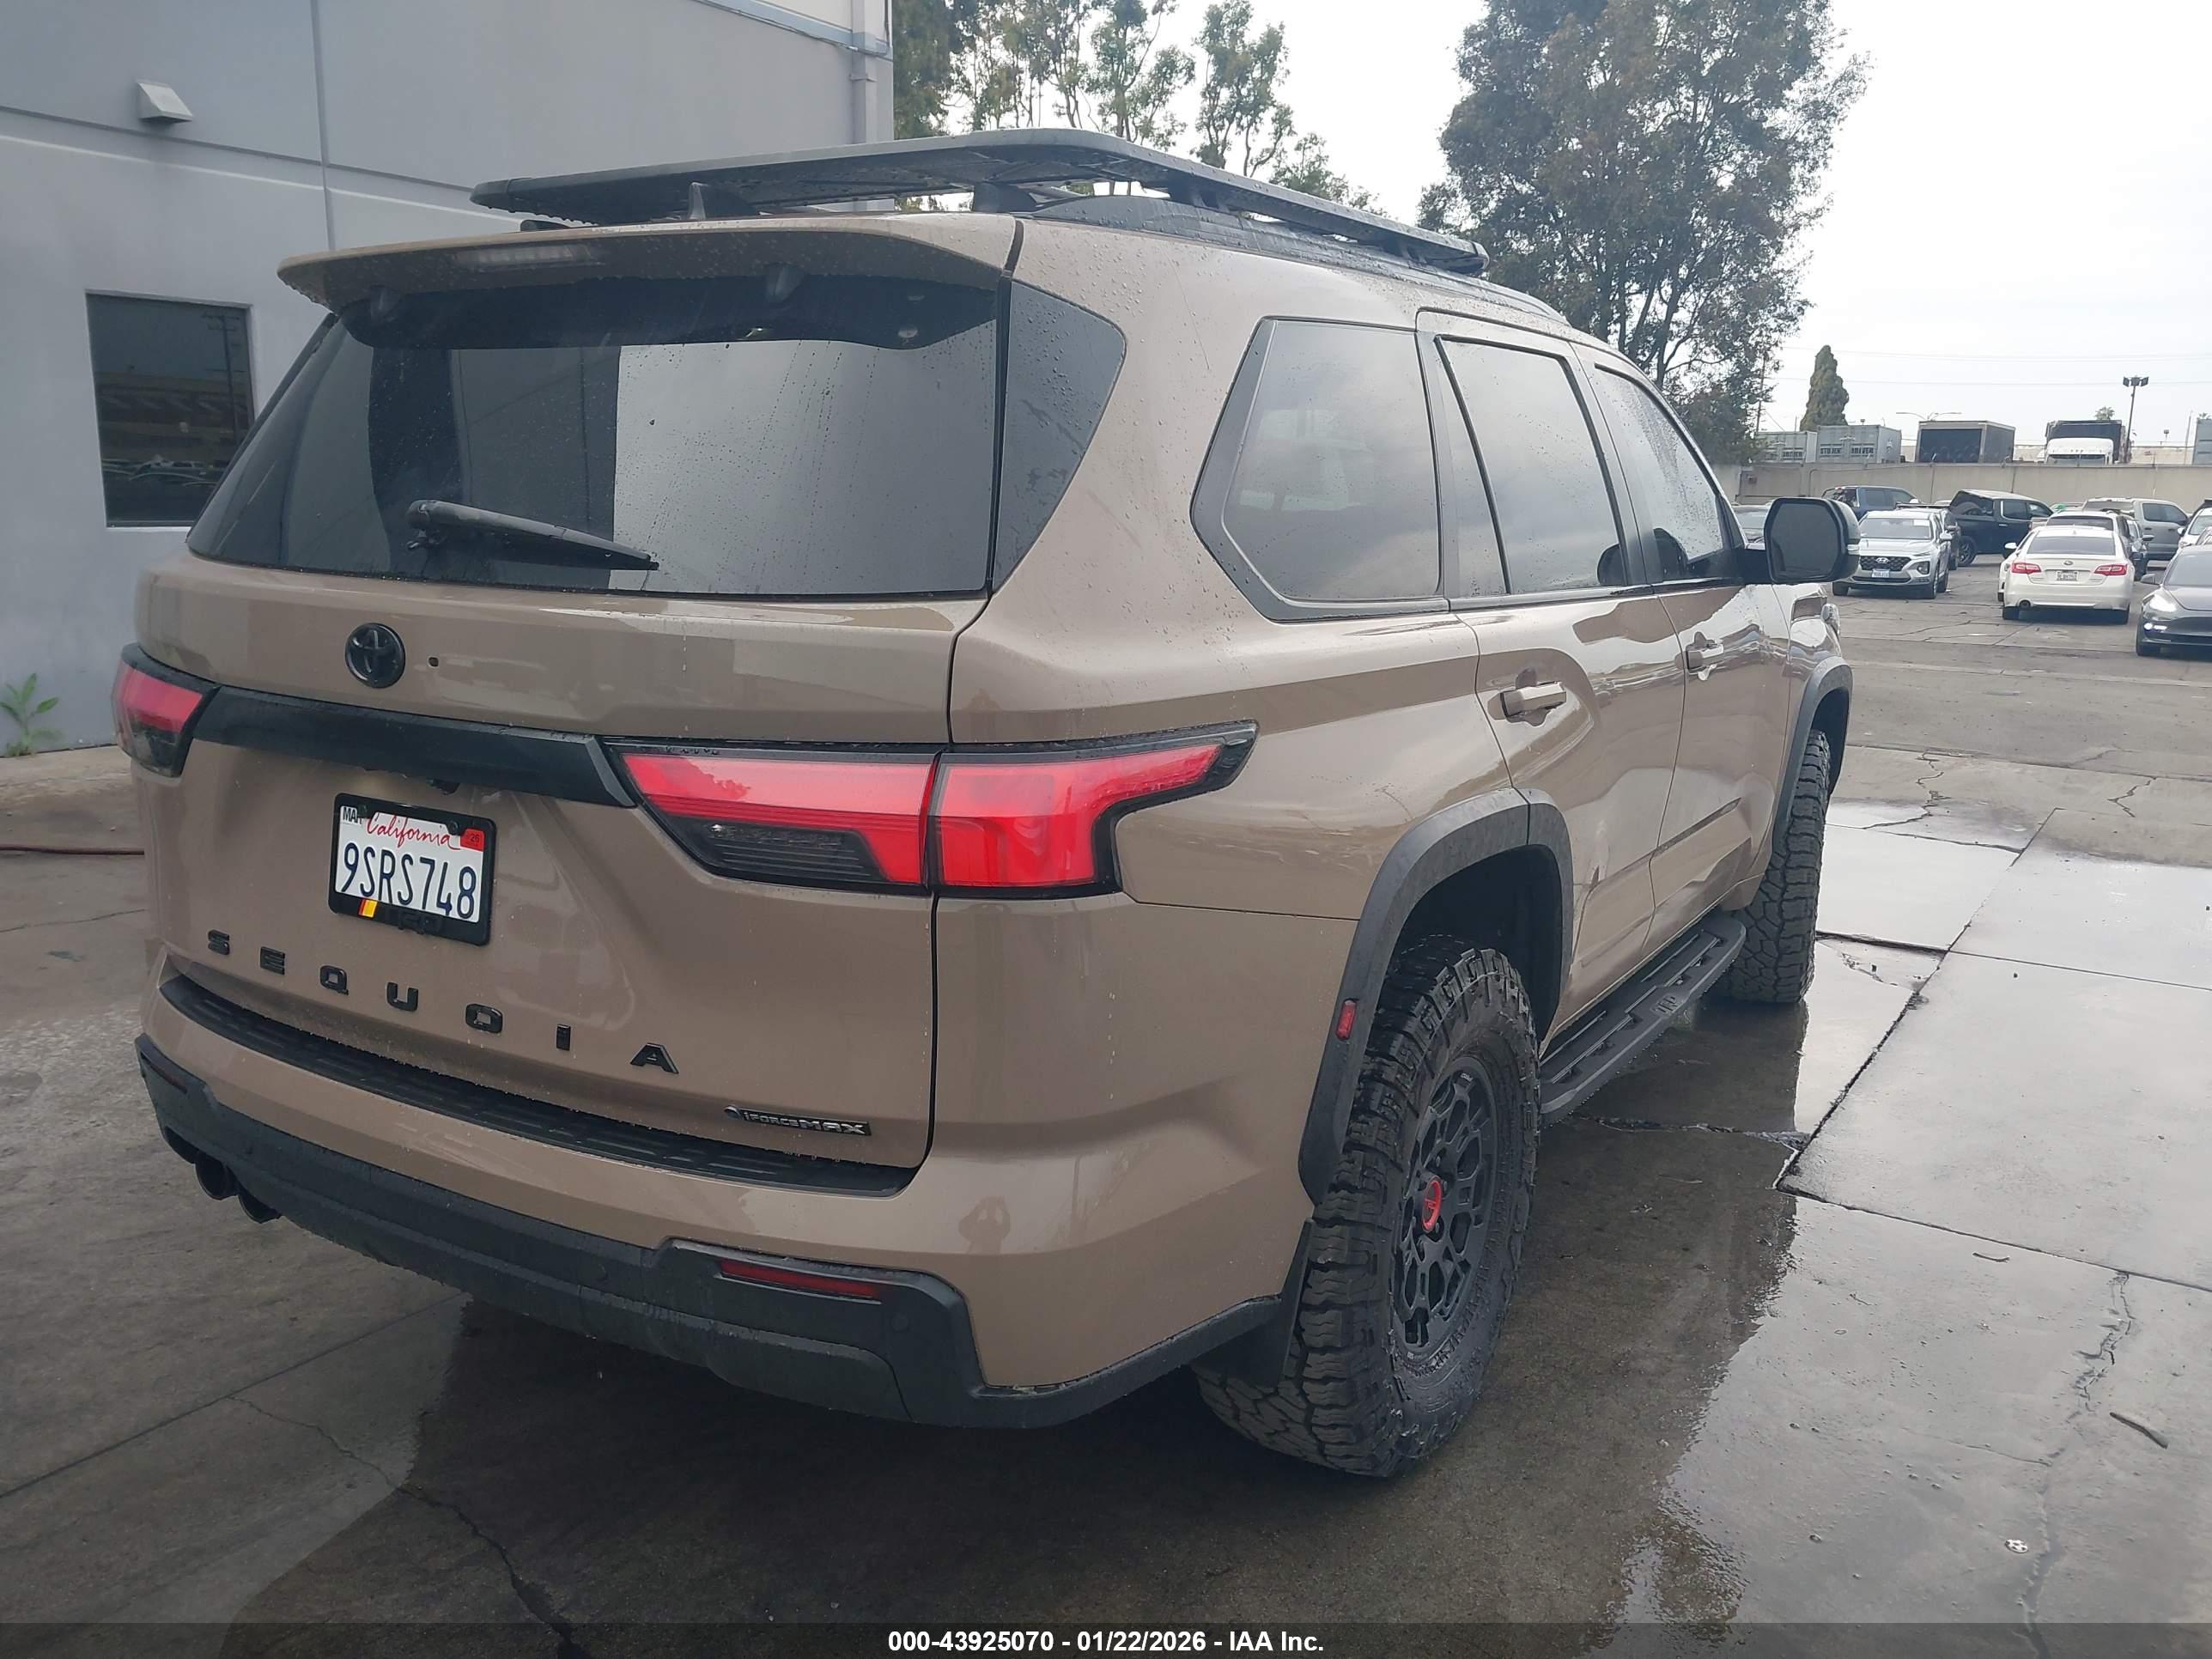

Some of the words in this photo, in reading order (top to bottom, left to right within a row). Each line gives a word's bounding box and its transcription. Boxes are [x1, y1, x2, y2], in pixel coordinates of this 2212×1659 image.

[366, 812, 461, 850] California
[341, 842, 477, 920] 9SRS748
[208, 929, 679, 1075] SEQUOIA
